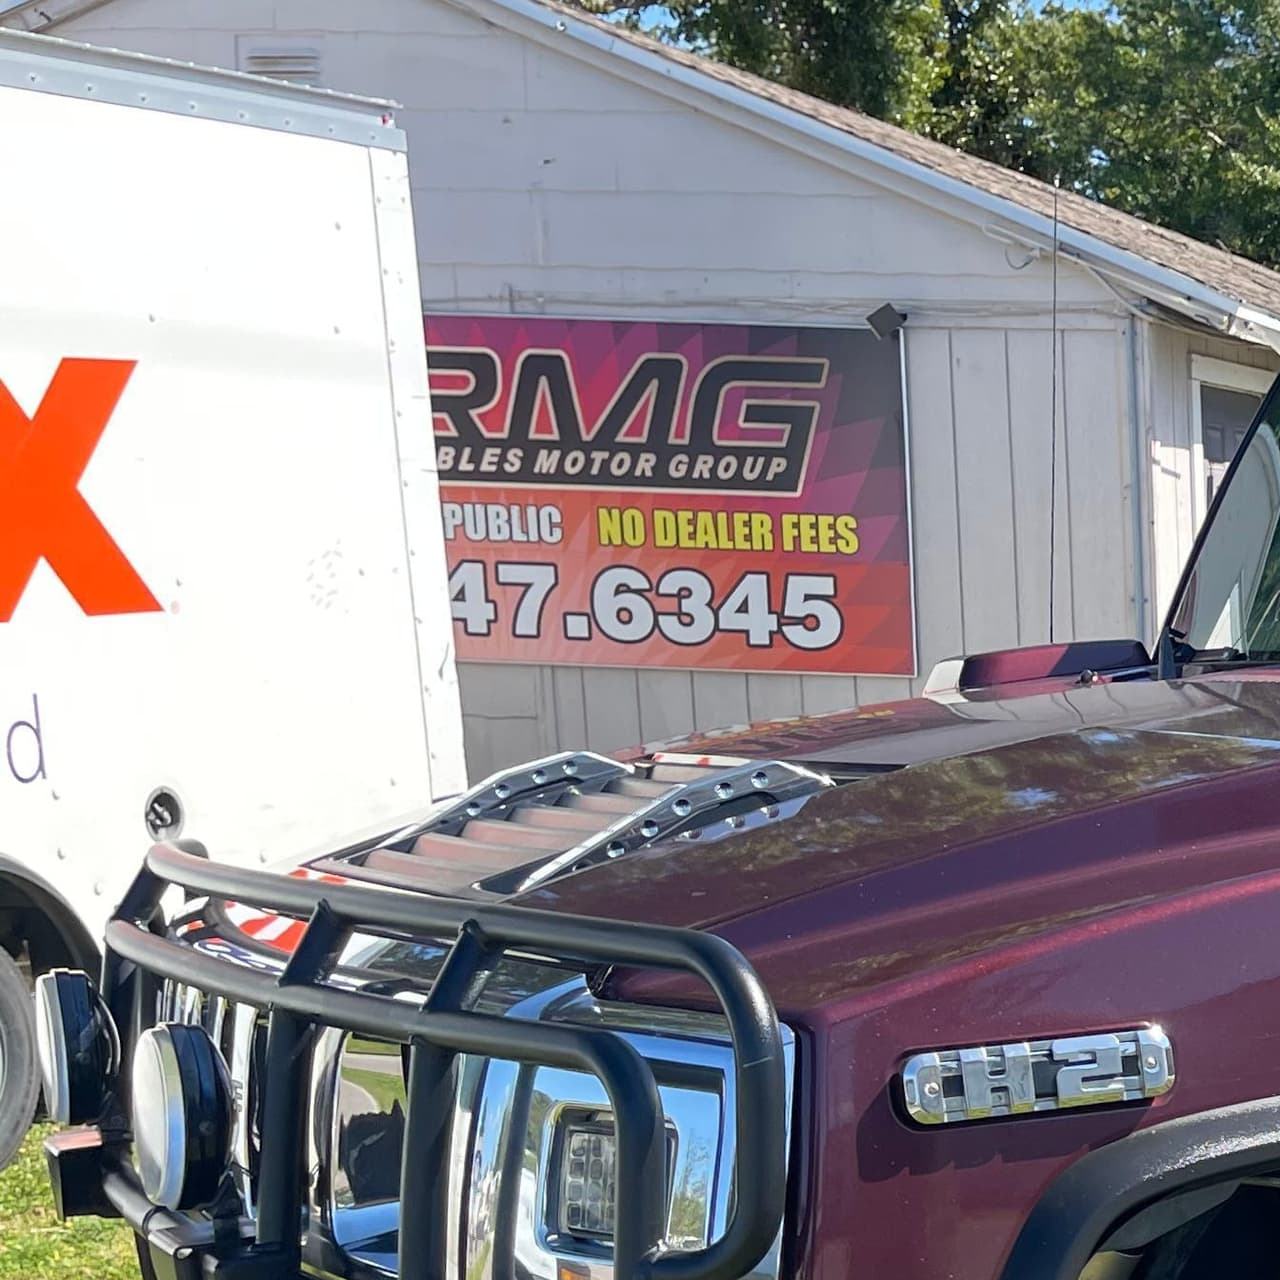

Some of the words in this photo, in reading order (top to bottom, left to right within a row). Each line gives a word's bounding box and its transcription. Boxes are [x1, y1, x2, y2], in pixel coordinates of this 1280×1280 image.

[426, 346, 830, 447] RMG
[533, 448, 656, 478] MOTOR
[668, 453, 788, 482] GROUP
[442, 501, 564, 545] PUBLIC
[597, 506, 646, 548] NO
[652, 509, 775, 552] DEALER
[780, 513, 860, 555] FEES
[448, 559, 844, 651] 47.6345
[960, 1033, 1125, 1118] H2
